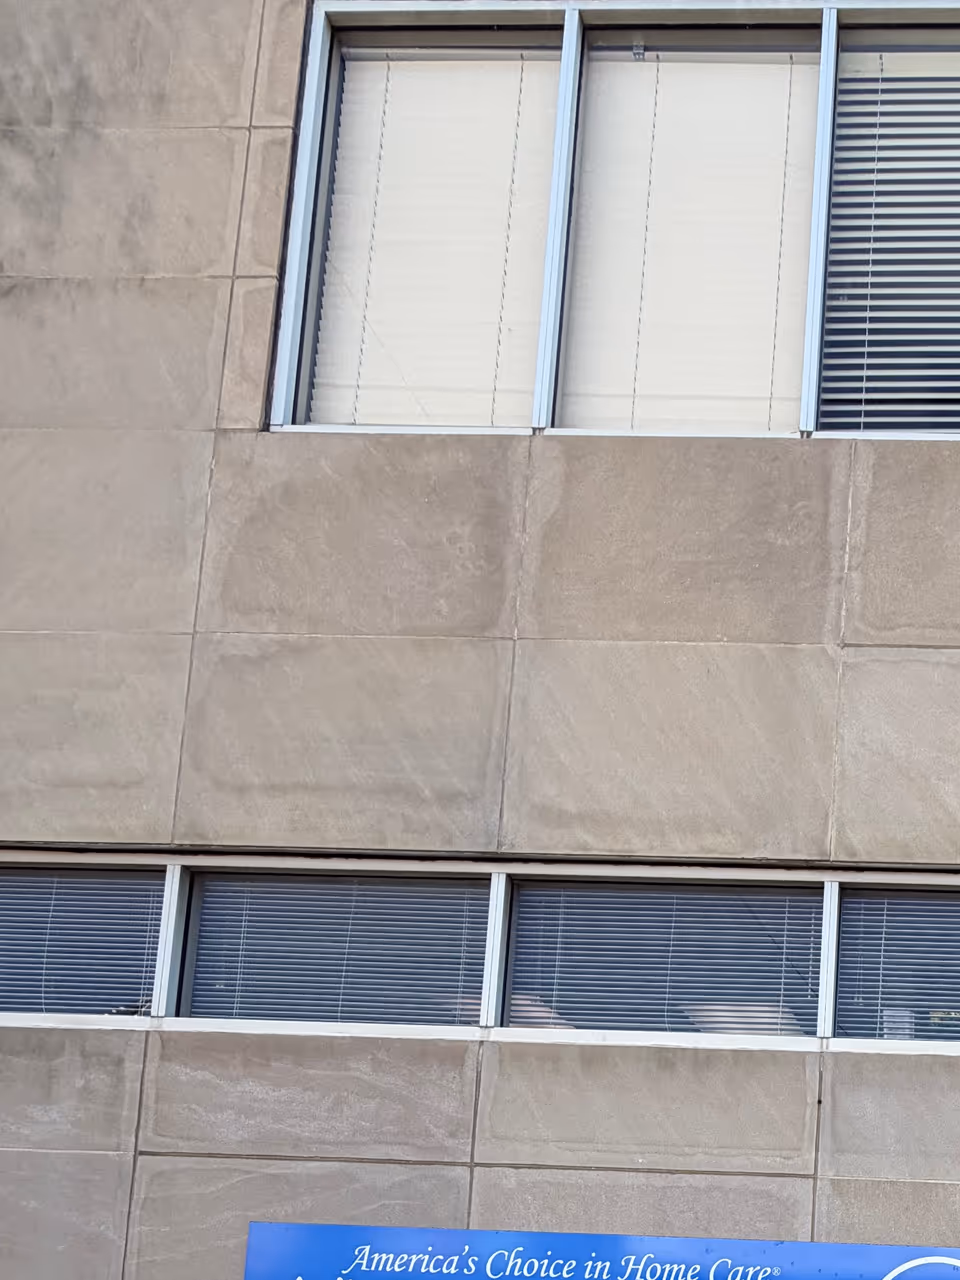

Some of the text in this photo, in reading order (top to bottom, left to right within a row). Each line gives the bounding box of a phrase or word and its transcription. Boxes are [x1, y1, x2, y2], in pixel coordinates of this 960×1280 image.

[341, 1245, 478, 1276] America's
[485, 1248, 576, 1280] Choice
[584, 1255, 611, 1280] in
